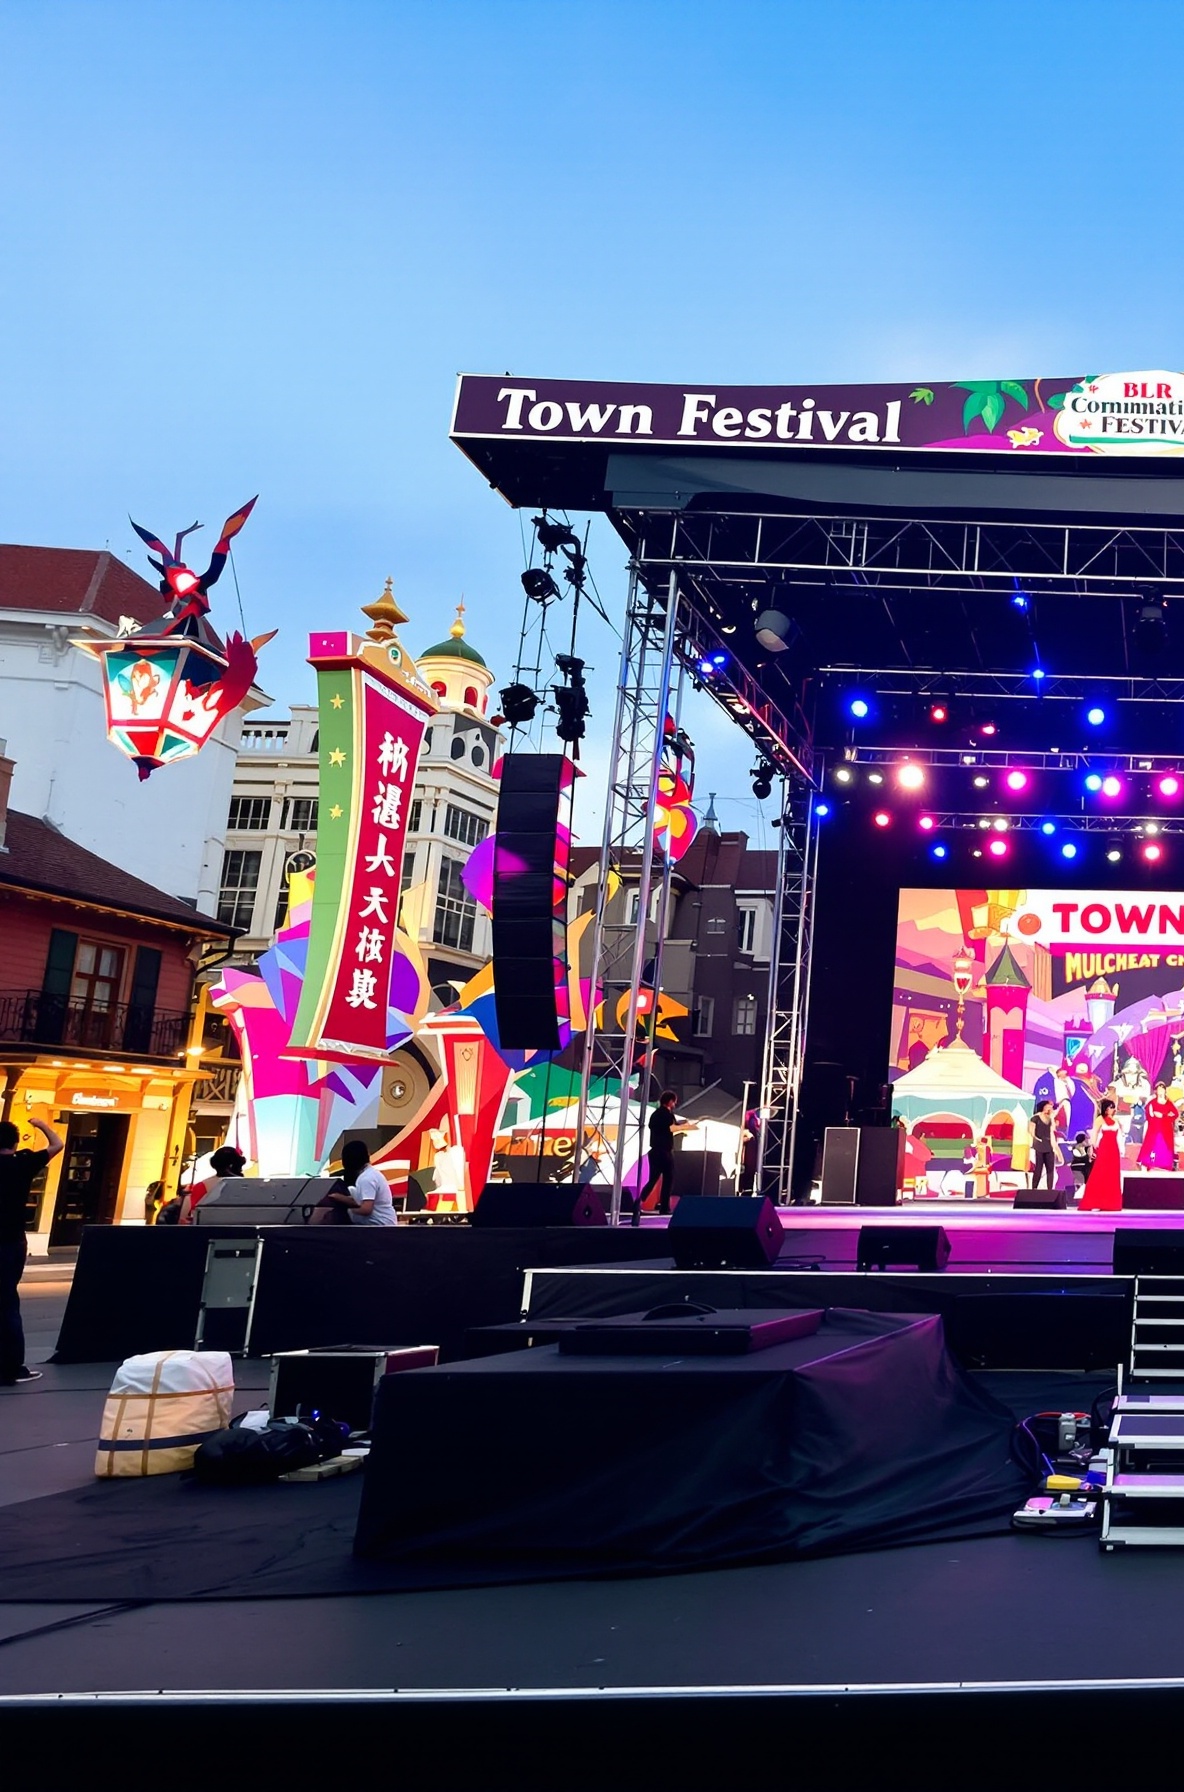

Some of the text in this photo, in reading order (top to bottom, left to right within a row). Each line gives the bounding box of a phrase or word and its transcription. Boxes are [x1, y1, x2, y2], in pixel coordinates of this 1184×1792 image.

[1124, 382, 1172, 398] BLR
[498, 387, 901, 442] Town Festival
